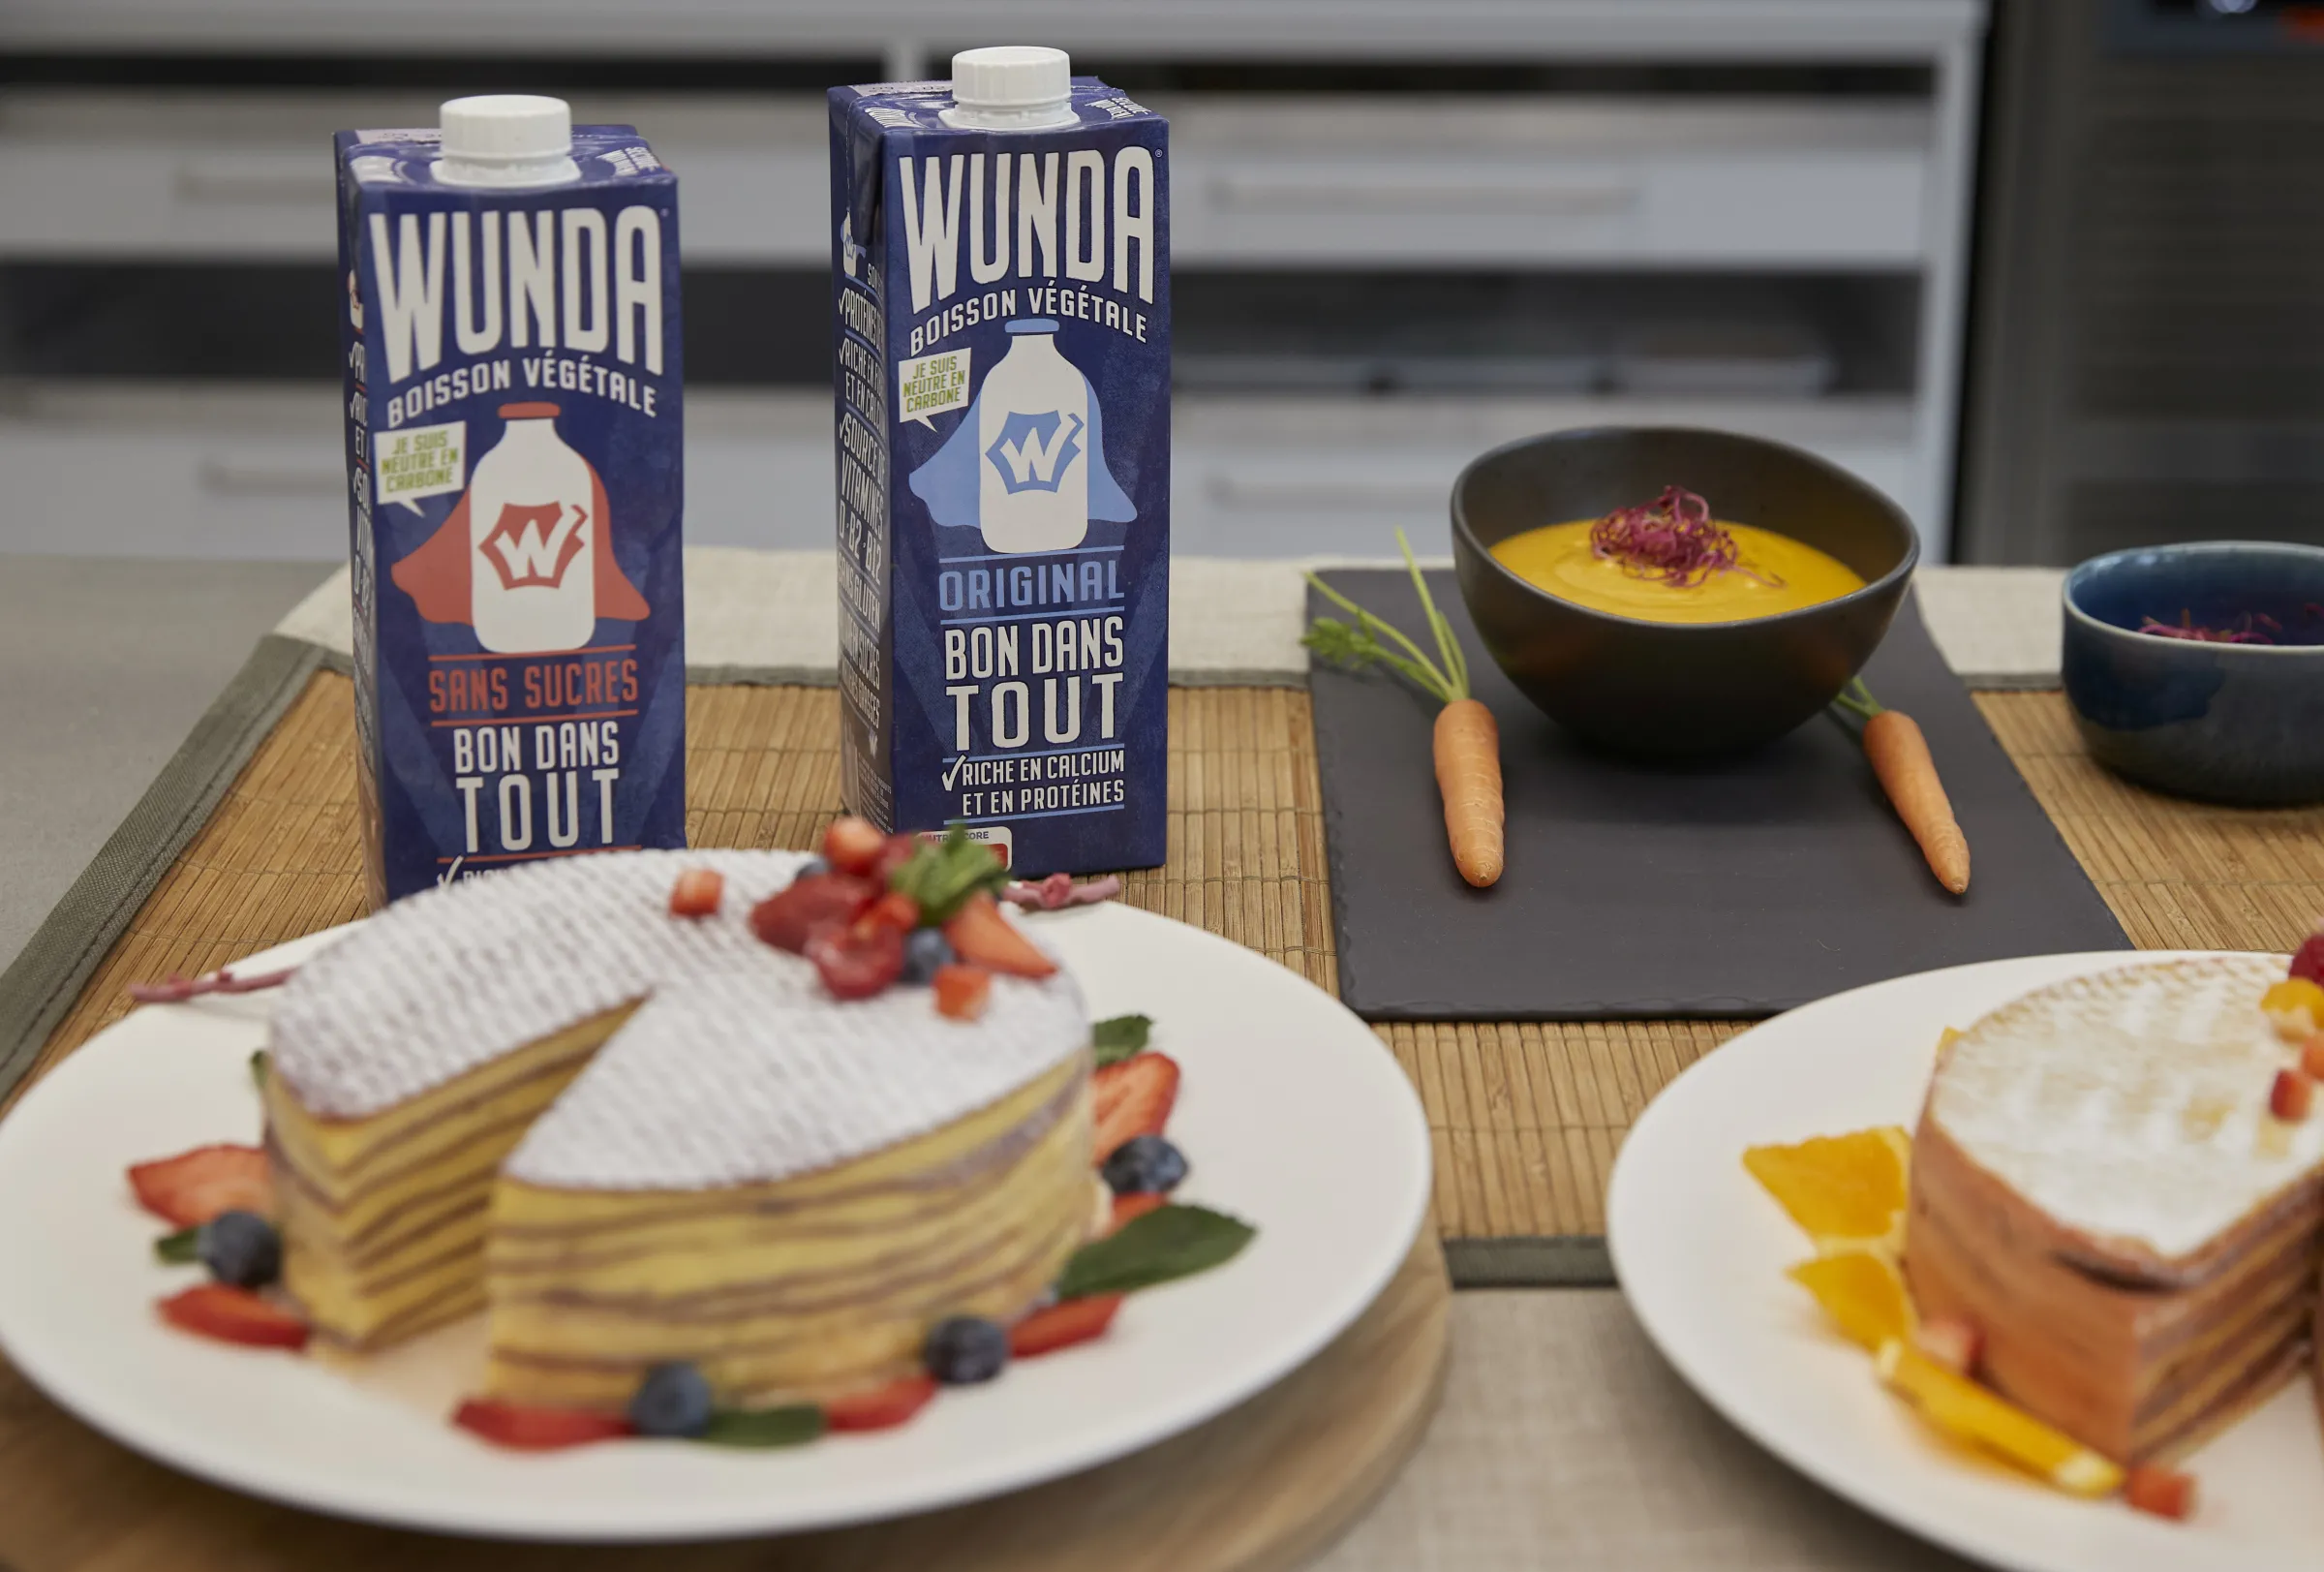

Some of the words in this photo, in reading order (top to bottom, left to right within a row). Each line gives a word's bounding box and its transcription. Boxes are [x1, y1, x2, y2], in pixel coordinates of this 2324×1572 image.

[899, 146, 1154, 314] WUNDA
[369, 205, 663, 384] WUNDA
[910, 289, 1016, 357] BOISSON
[1027, 280, 1147, 343] VÉGÉTALE
[844, 338, 867, 380] RICHE
[903, 374, 946, 397] NEUTRE
[951, 369, 965, 385] EN
[912, 362, 926, 379] JE
[930, 355, 957, 375] SUIS
[388, 359, 510, 428] BOISSON
[523, 350, 657, 416] VÉGÉTALE
[845, 371, 855, 404] ET
[857, 380, 866, 414] EN
[906, 387, 961, 413] CARBONE
[382, 452, 434, 475] NEUTRE
[441, 447, 458, 465] EN
[392, 437, 408, 454] JE
[414, 429, 447, 450] SUIS
[843, 412, 877, 478] SOURCE
[385, 467, 453, 492] CARBONE
[841, 450, 884, 541] VITAMINES
[854, 573, 880, 633] GLUTEN
[939, 561, 1125, 611] ORIGINAL
[944, 625, 1019, 680] BON
[1031, 616, 1123, 673] DANS
[429, 666, 507, 712] SANS
[525, 659, 639, 709] SUCRES
[946, 673, 1124, 752] TOUT
[453, 726, 521, 773] BON
[535, 721, 619, 769] DANS
[963, 758, 1014, 786] RICHE
[1020, 757, 1041, 782] EN
[1047, 750, 1124, 778] CALCIUM
[456, 768, 619, 852] TOUT
[963, 792, 982, 816] ET
[991, 789, 1013, 814] EN
[1021, 780, 1124, 813] PROTÉINES
